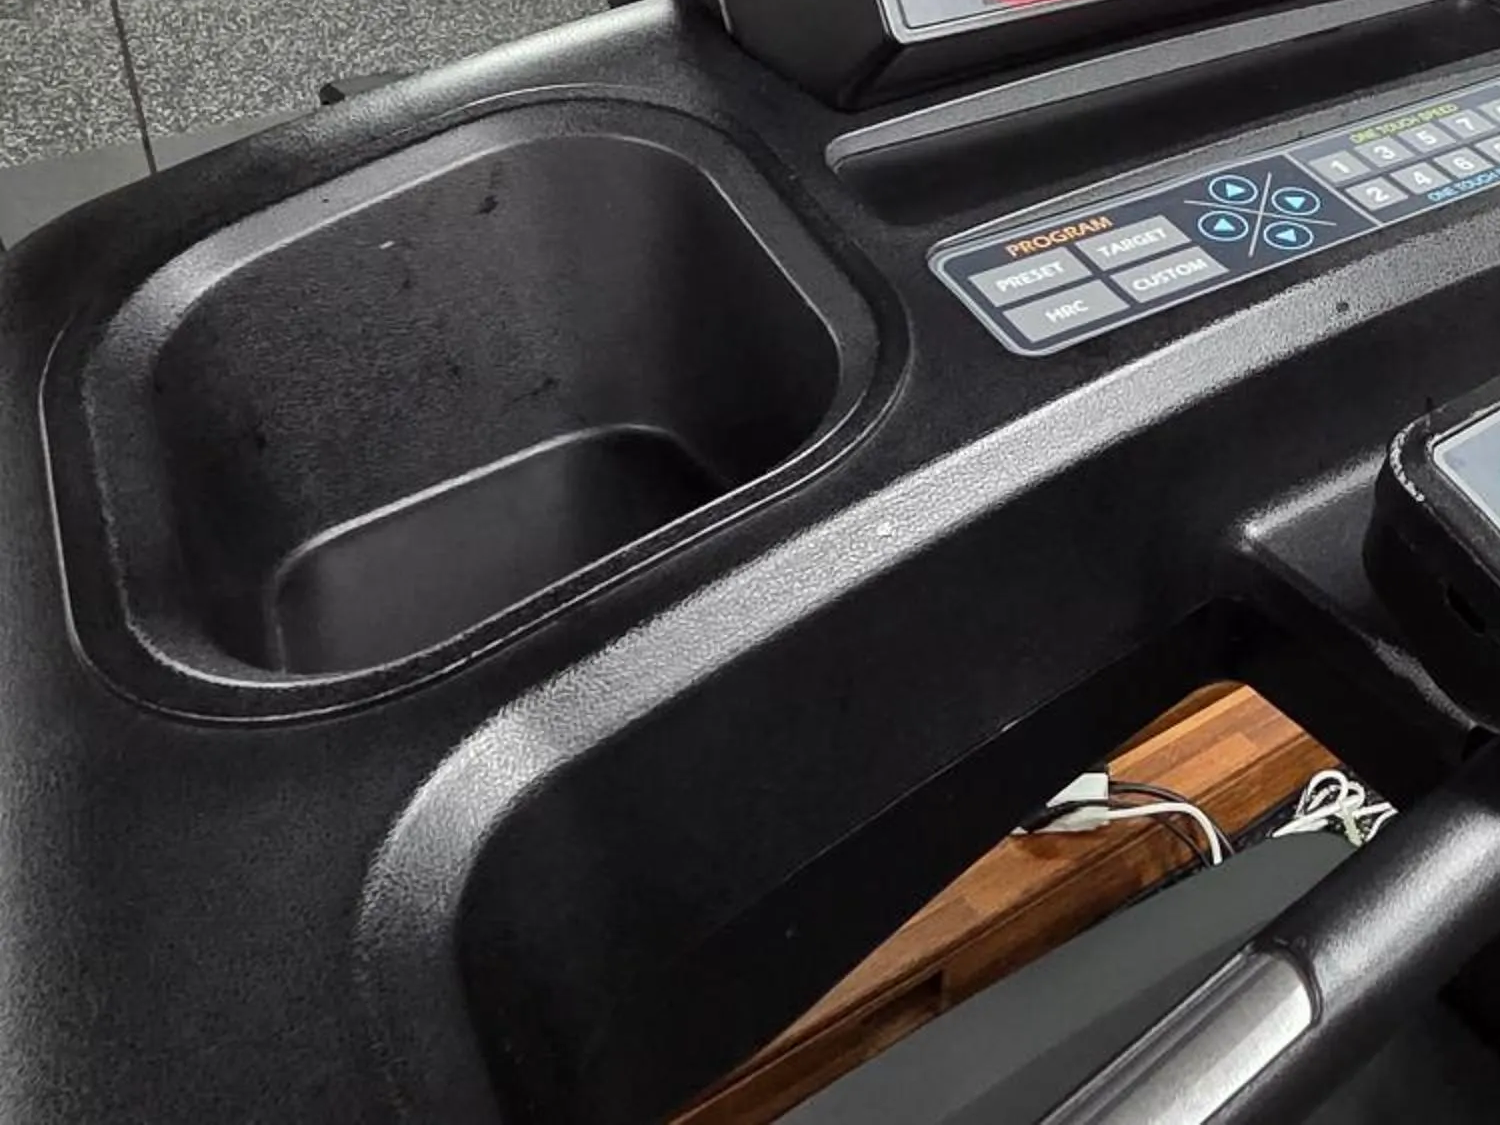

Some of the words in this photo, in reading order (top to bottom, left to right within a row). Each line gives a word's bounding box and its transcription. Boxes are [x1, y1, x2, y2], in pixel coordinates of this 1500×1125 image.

[1350, 128, 1376, 144] ONE
[1376, 115, 1421, 135] TOUCH
[1418, 102, 1458, 121] SPEED
[1455, 117, 1476, 132] 7
[1417, 129, 1437, 145] 5
[1373, 144, 1396, 162] 3
[1331, 160, 1350, 175] 1
[1452, 155, 1475, 171] 6
[1410, 170, 1430, 186] 4
[1427, 186, 1460, 202] ONE
[1454, 171, 1499, 191] TOUCH
[1366, 186, 1389, 202] 2
[1004, 215, 1114, 258] PROGRAM
[1096, 227, 1168, 258] TARGET
[996, 261, 1065, 293] PRESET
[1132, 257, 1209, 291] CUSTOM
